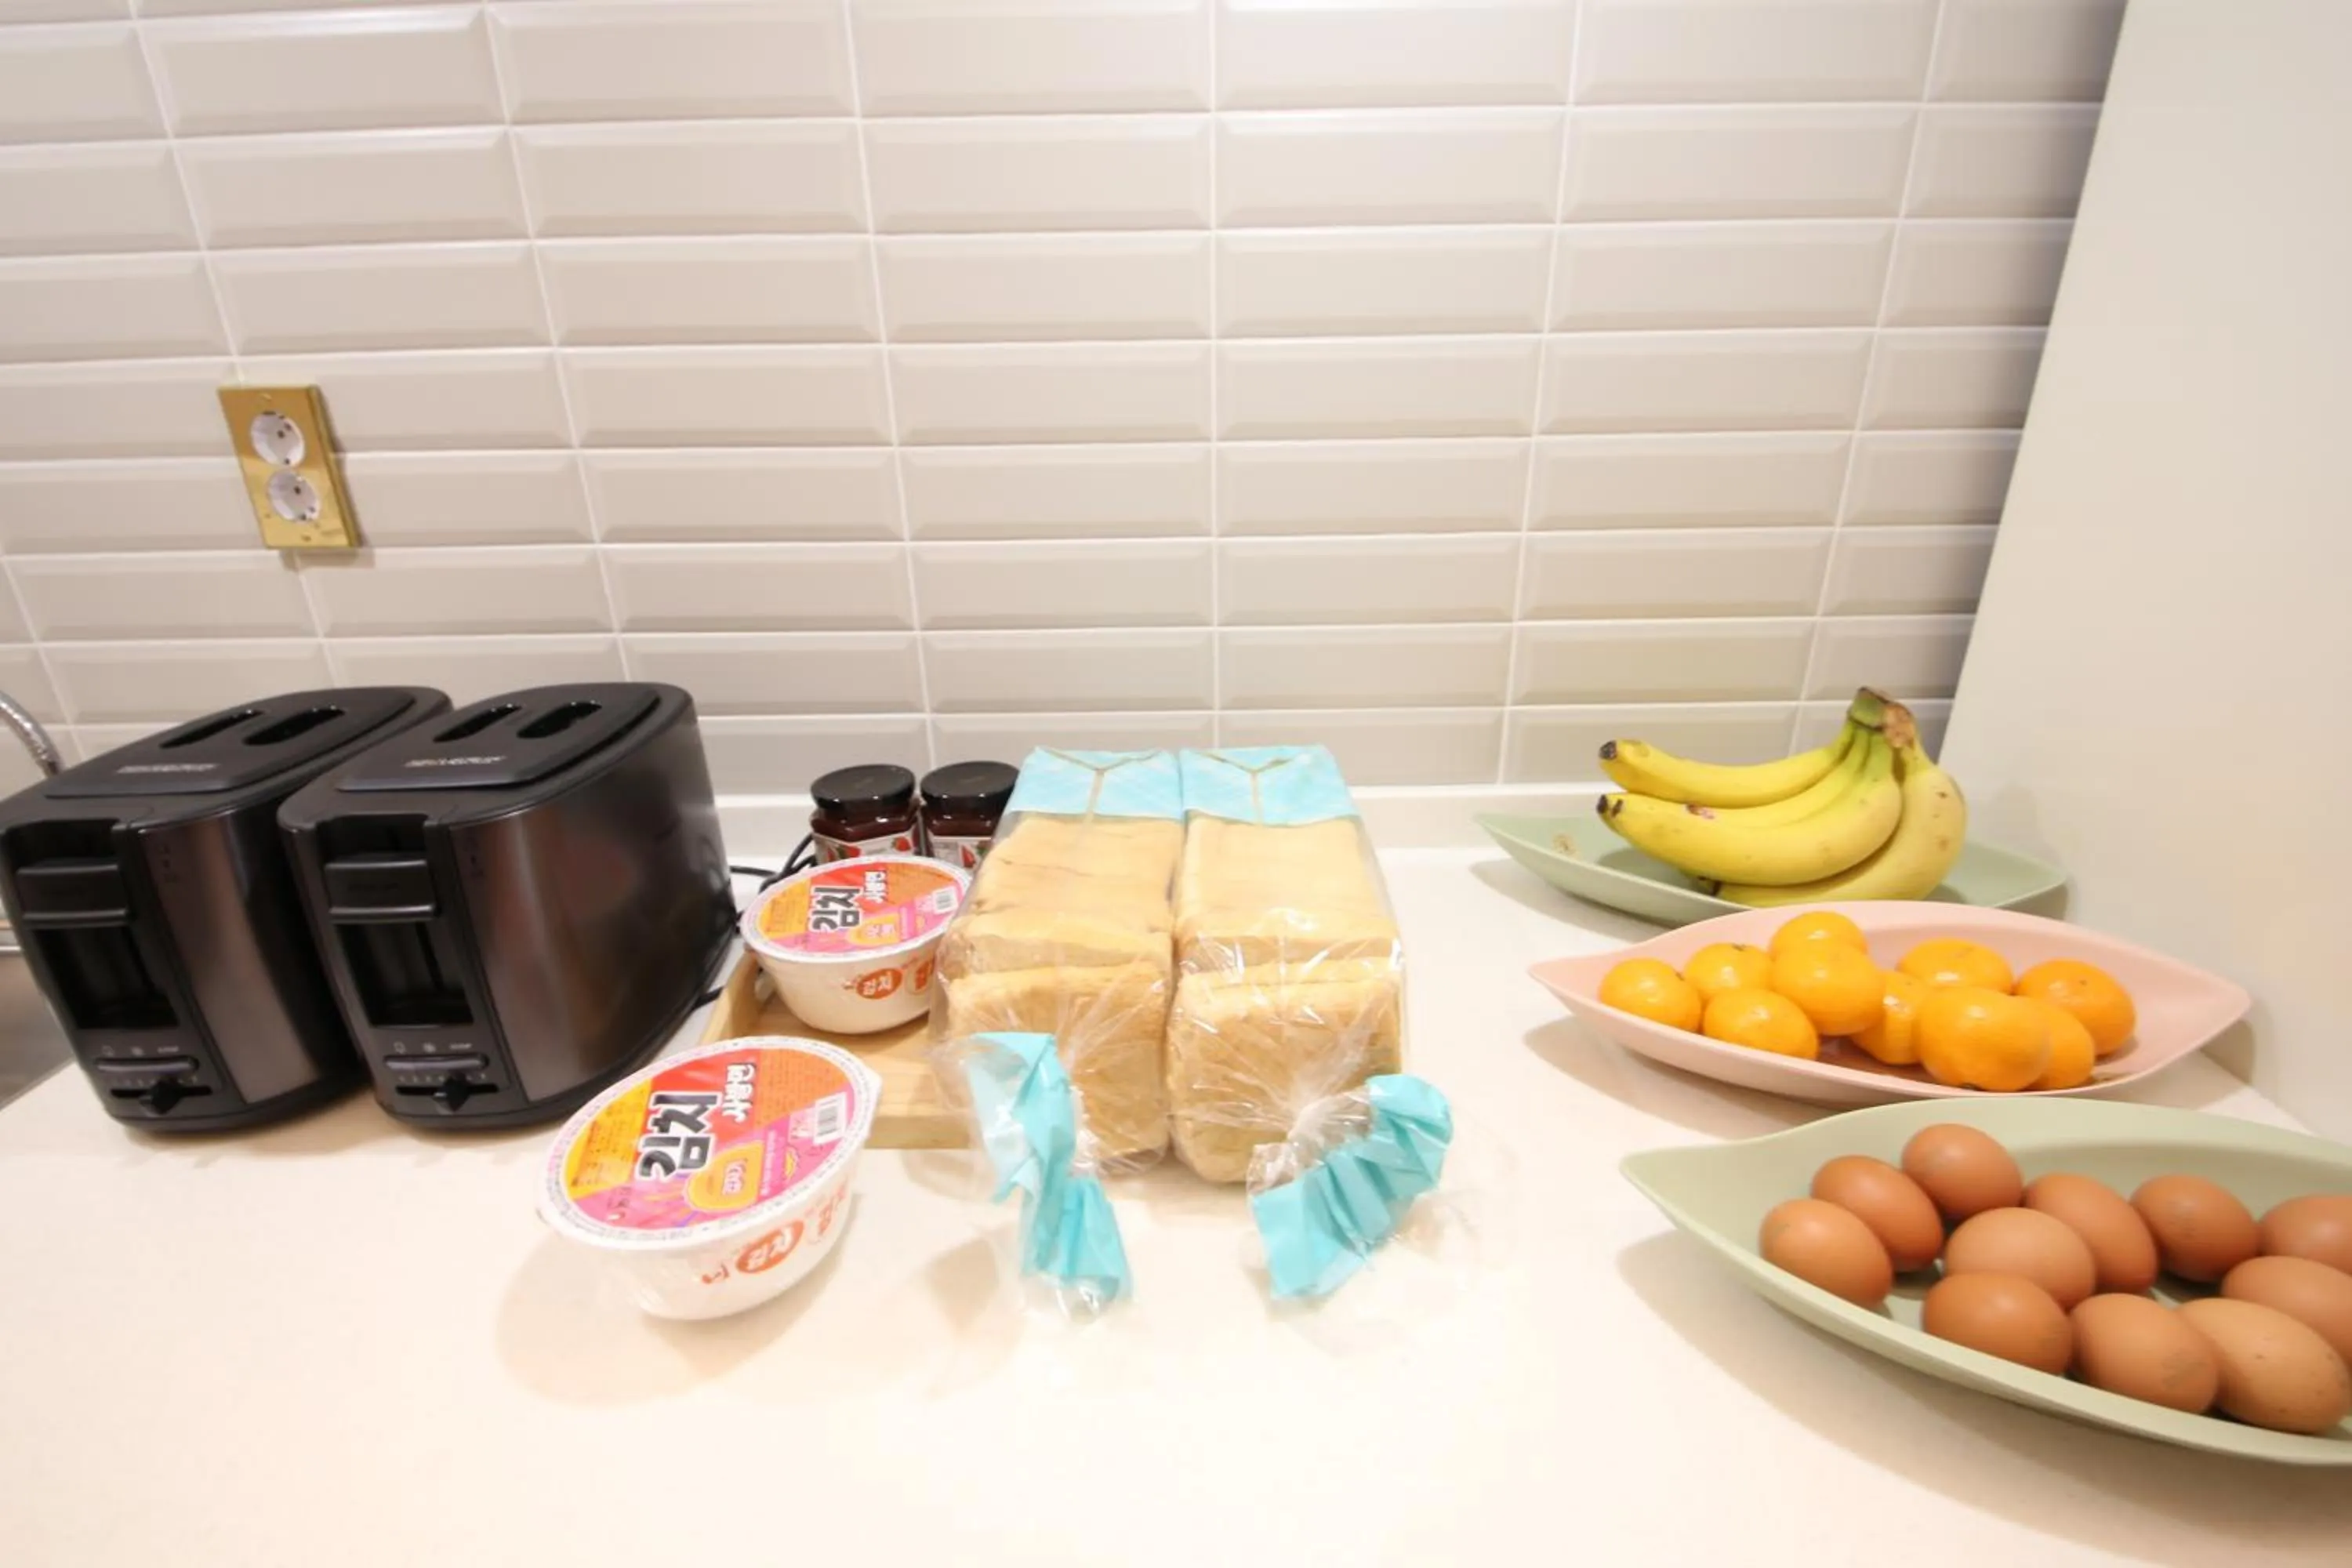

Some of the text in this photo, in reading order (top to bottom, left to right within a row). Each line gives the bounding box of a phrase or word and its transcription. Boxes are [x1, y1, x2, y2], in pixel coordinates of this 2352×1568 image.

[812, 887, 860, 931] 김치
[864, 871, 886, 903] 사발면
[722, 1064, 755, 1122] 사발면
[639, 1094, 718, 1178] 김치
